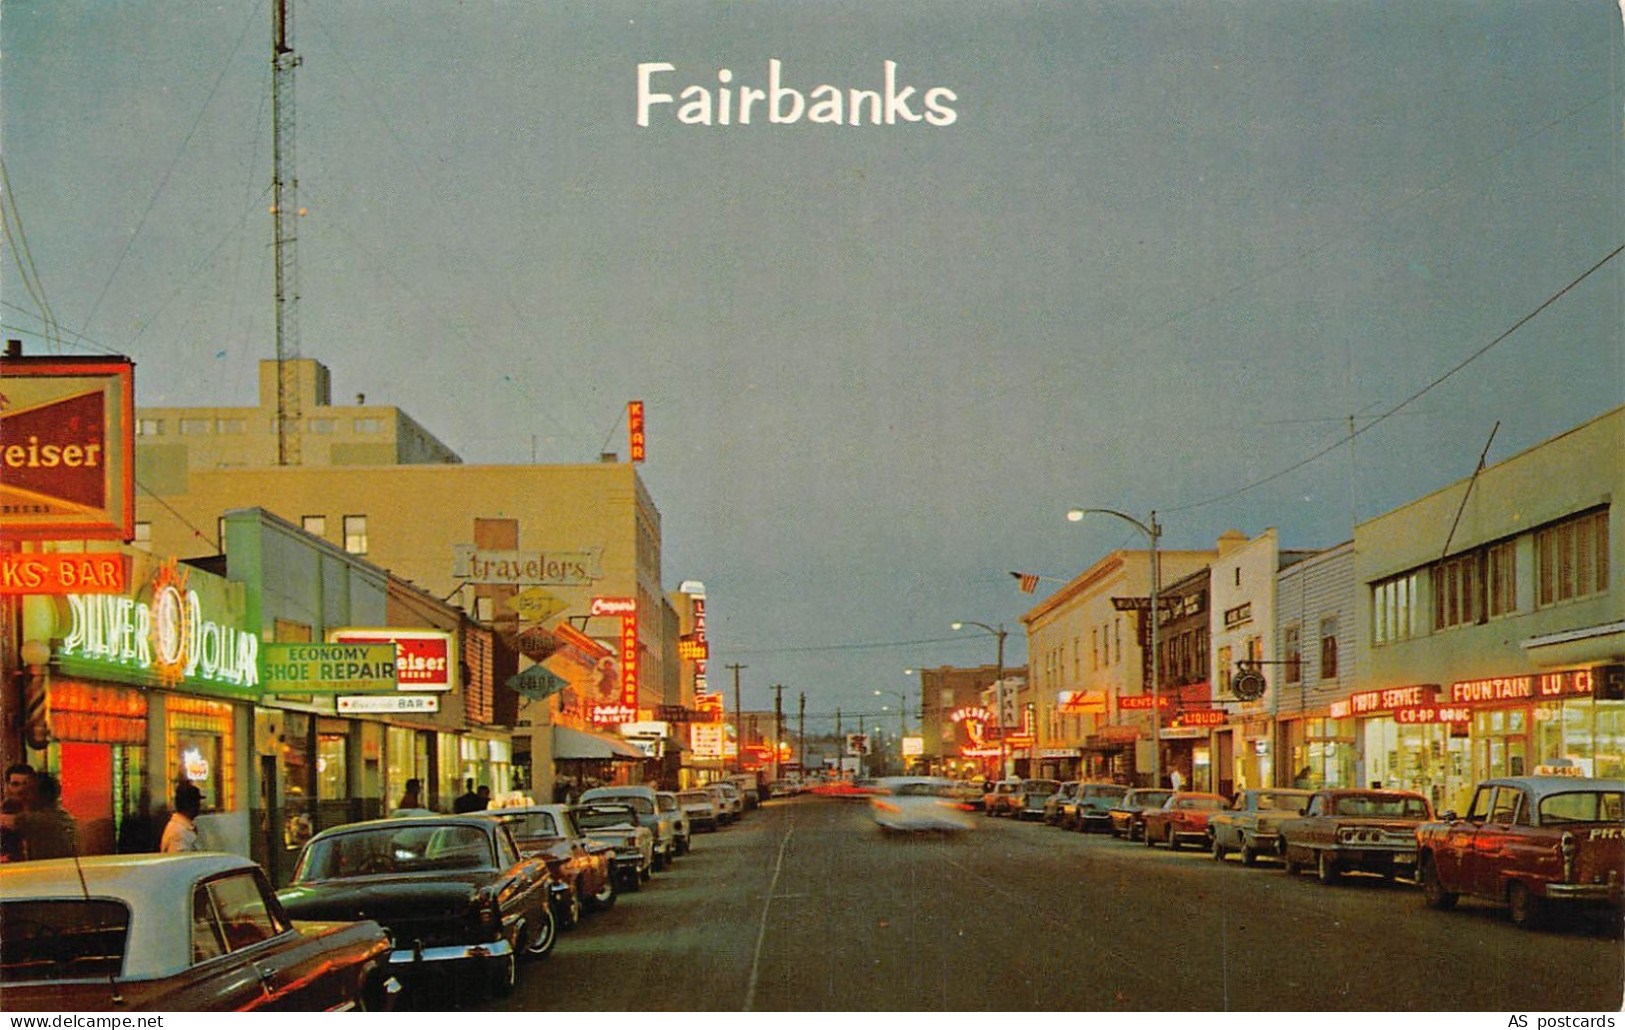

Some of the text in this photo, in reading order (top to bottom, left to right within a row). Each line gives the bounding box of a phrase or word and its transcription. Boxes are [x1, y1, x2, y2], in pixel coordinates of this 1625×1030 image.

[632, 403, 644, 458] KFAR
[0, 434, 102, 469] eiser
[60, 561, 118, 588] BAR
[470, 554, 586, 581] travelers
[184, 589, 259, 687] DOLLAR
[288, 647, 370, 661] ECONOMY
[624, 617, 636, 704] HARDWARE
[264, 663, 309, 681] SHOE
[320, 662, 395, 680] REPAIR
[1122, 695, 1168, 708] CENTR
[1382, 683, 1422, 708] SERVICE
[1454, 676, 1532, 702] FOUNTAIN
[398, 699, 424, 709] BAR
[593, 714, 636, 723] PAINTS
[1184, 711, 1223, 725] LIQUOR
